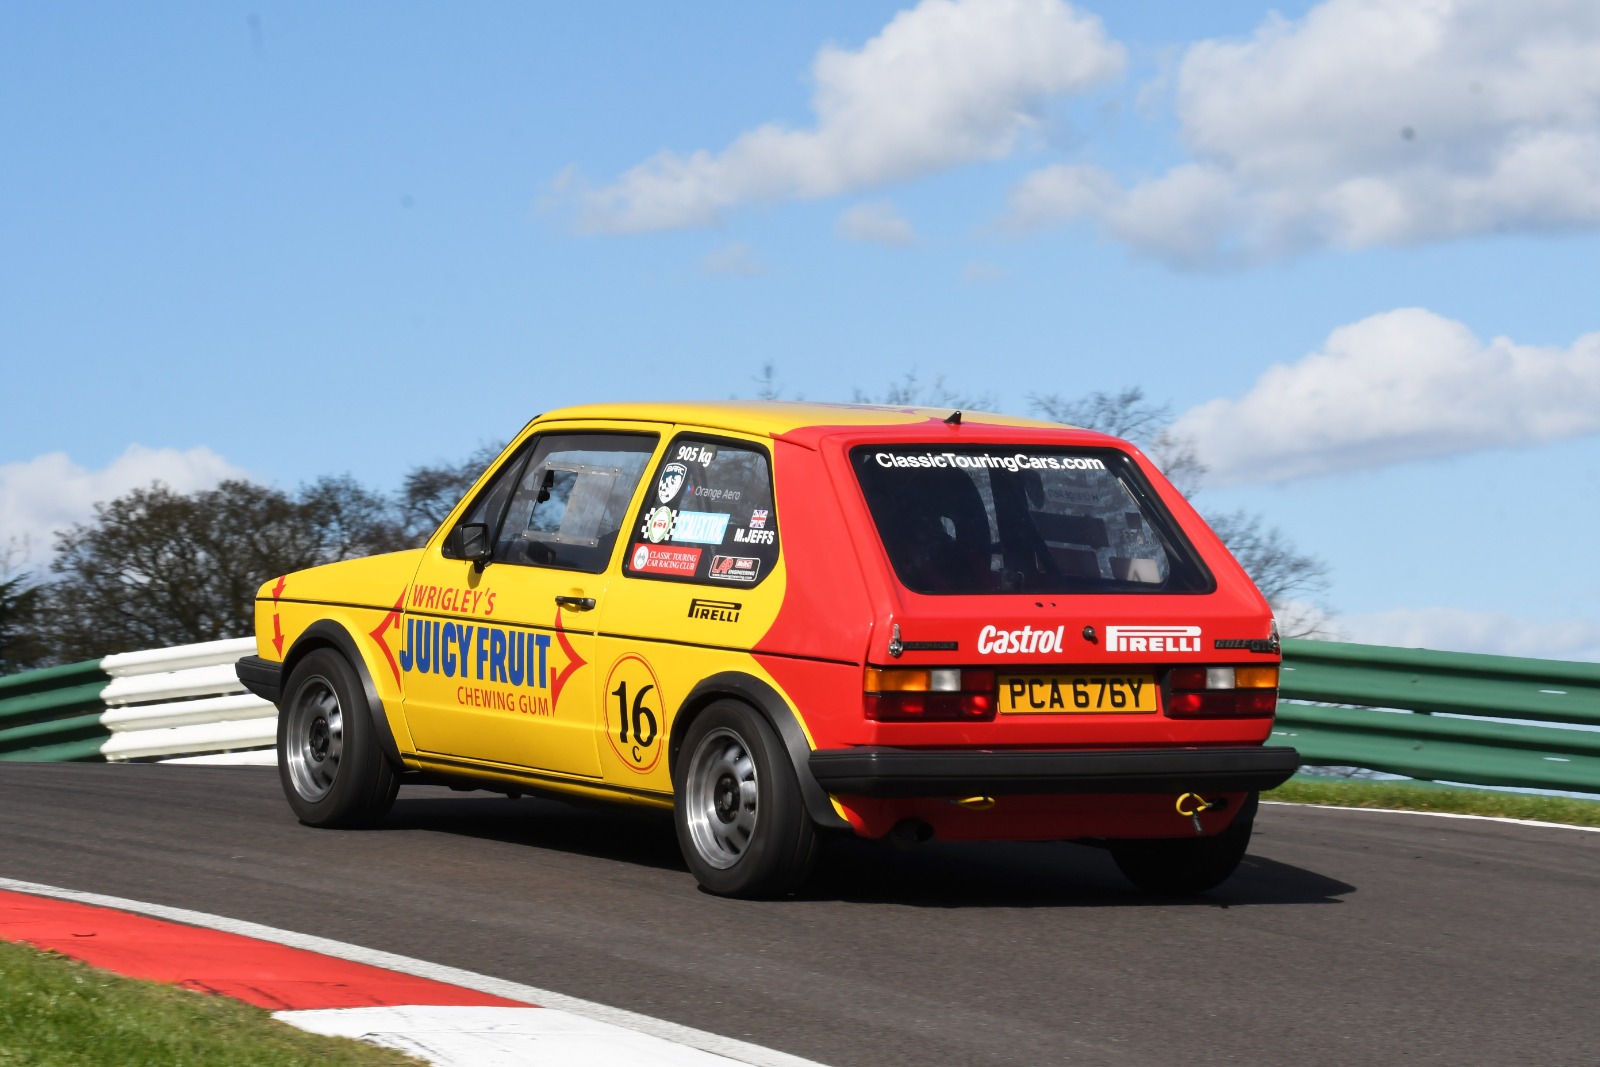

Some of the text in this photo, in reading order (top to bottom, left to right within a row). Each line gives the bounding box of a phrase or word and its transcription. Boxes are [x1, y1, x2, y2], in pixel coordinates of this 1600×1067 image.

[677, 445, 713, 467] 905 kg
[875, 453, 1105, 472] ClassicTouringCars.com
[666, 465, 685, 475] BARC
[695, 485, 741, 501] Orange Aero
[734, 528, 774, 545] M.JEFFS
[647, 559, 695, 570] CAR RACING CLUB
[649, 551, 697, 562] CLASSIC TOURING
[413, 584, 496, 615] WRIGLEY'S
[688, 598, 742, 623] PIRELLI
[977, 624, 1065, 655] Castrol
[1106, 625, 1201, 652] PIRELLI
[399, 618, 551, 688] JUICY FRUIT
[457, 686, 549, 716] CHEWING GUM
[1009, 678, 1144, 709] PCA 676Y
[612, 681, 658, 747] 16
